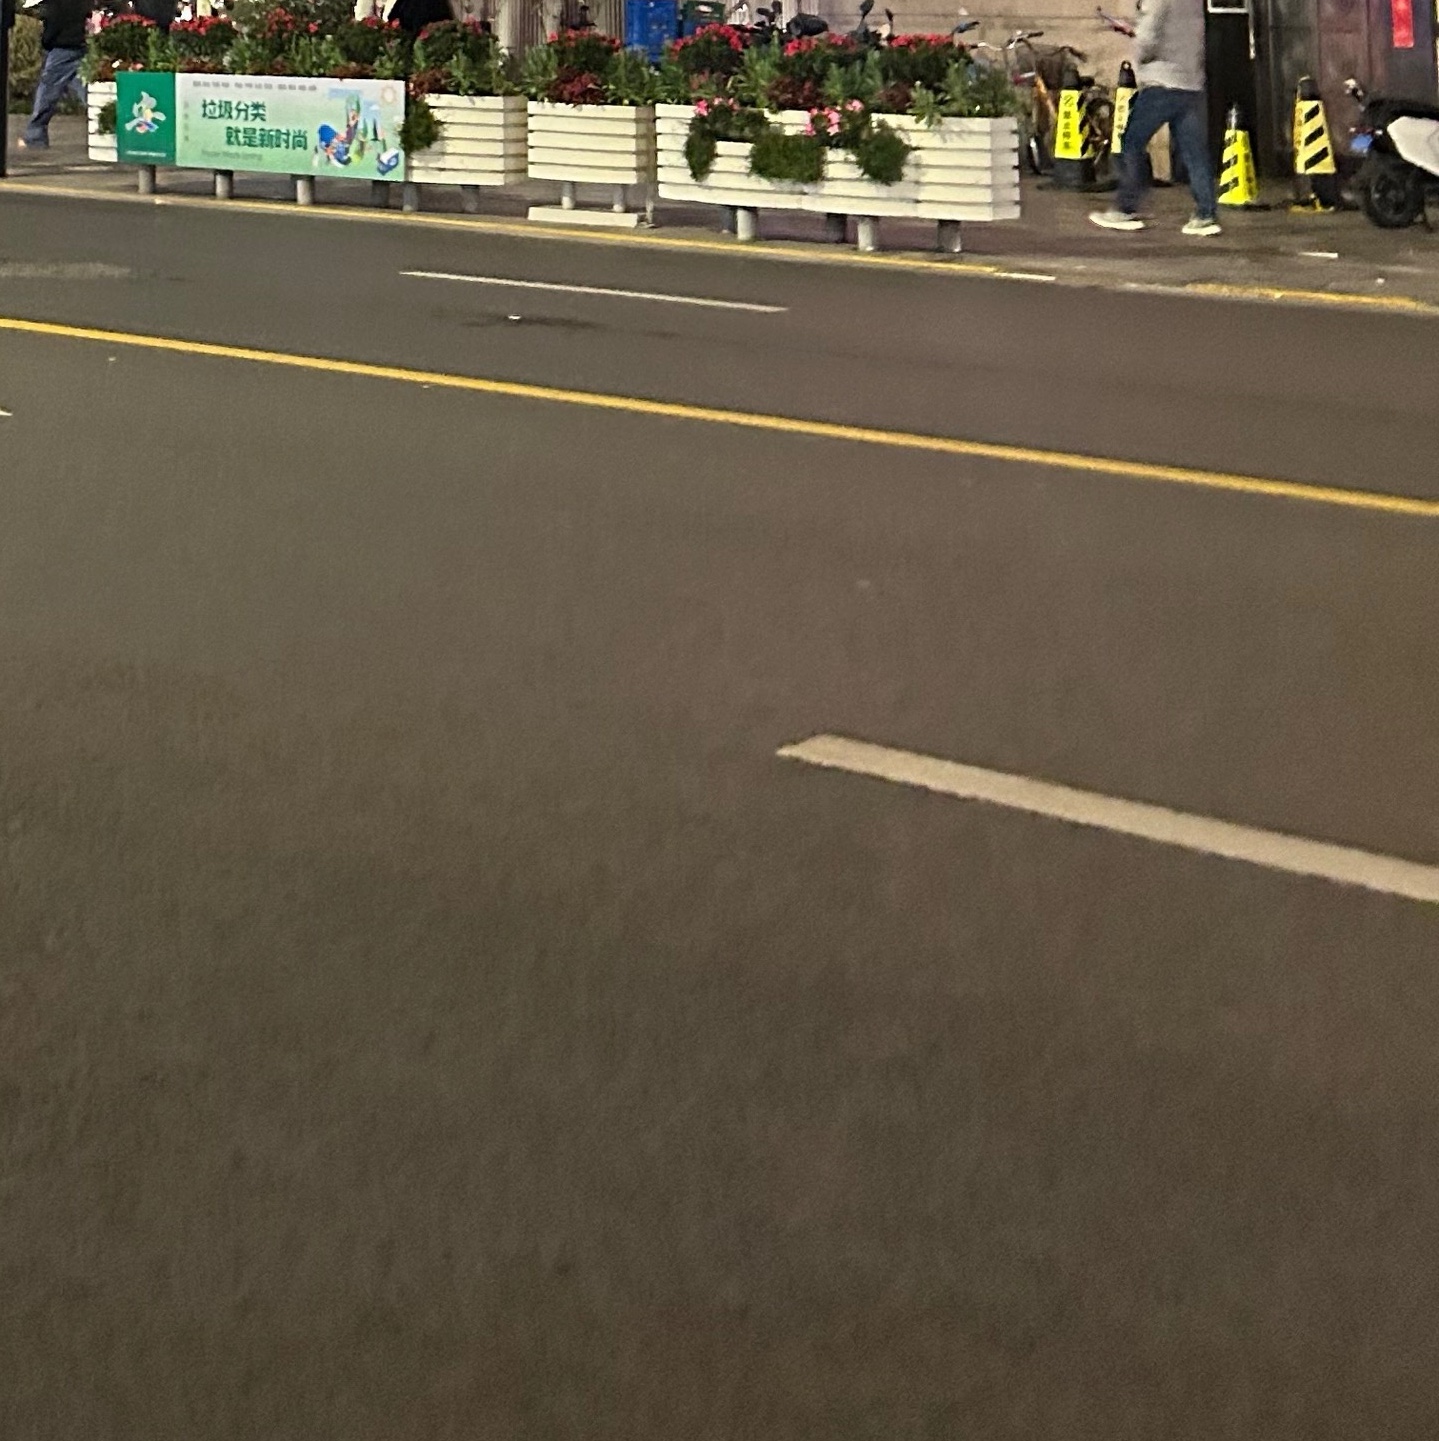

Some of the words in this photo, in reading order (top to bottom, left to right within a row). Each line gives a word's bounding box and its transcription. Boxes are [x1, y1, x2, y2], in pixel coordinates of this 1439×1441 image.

[201, 98, 267, 122] 垃圾分类
[225, 125, 308, 151] 就是新时尚
